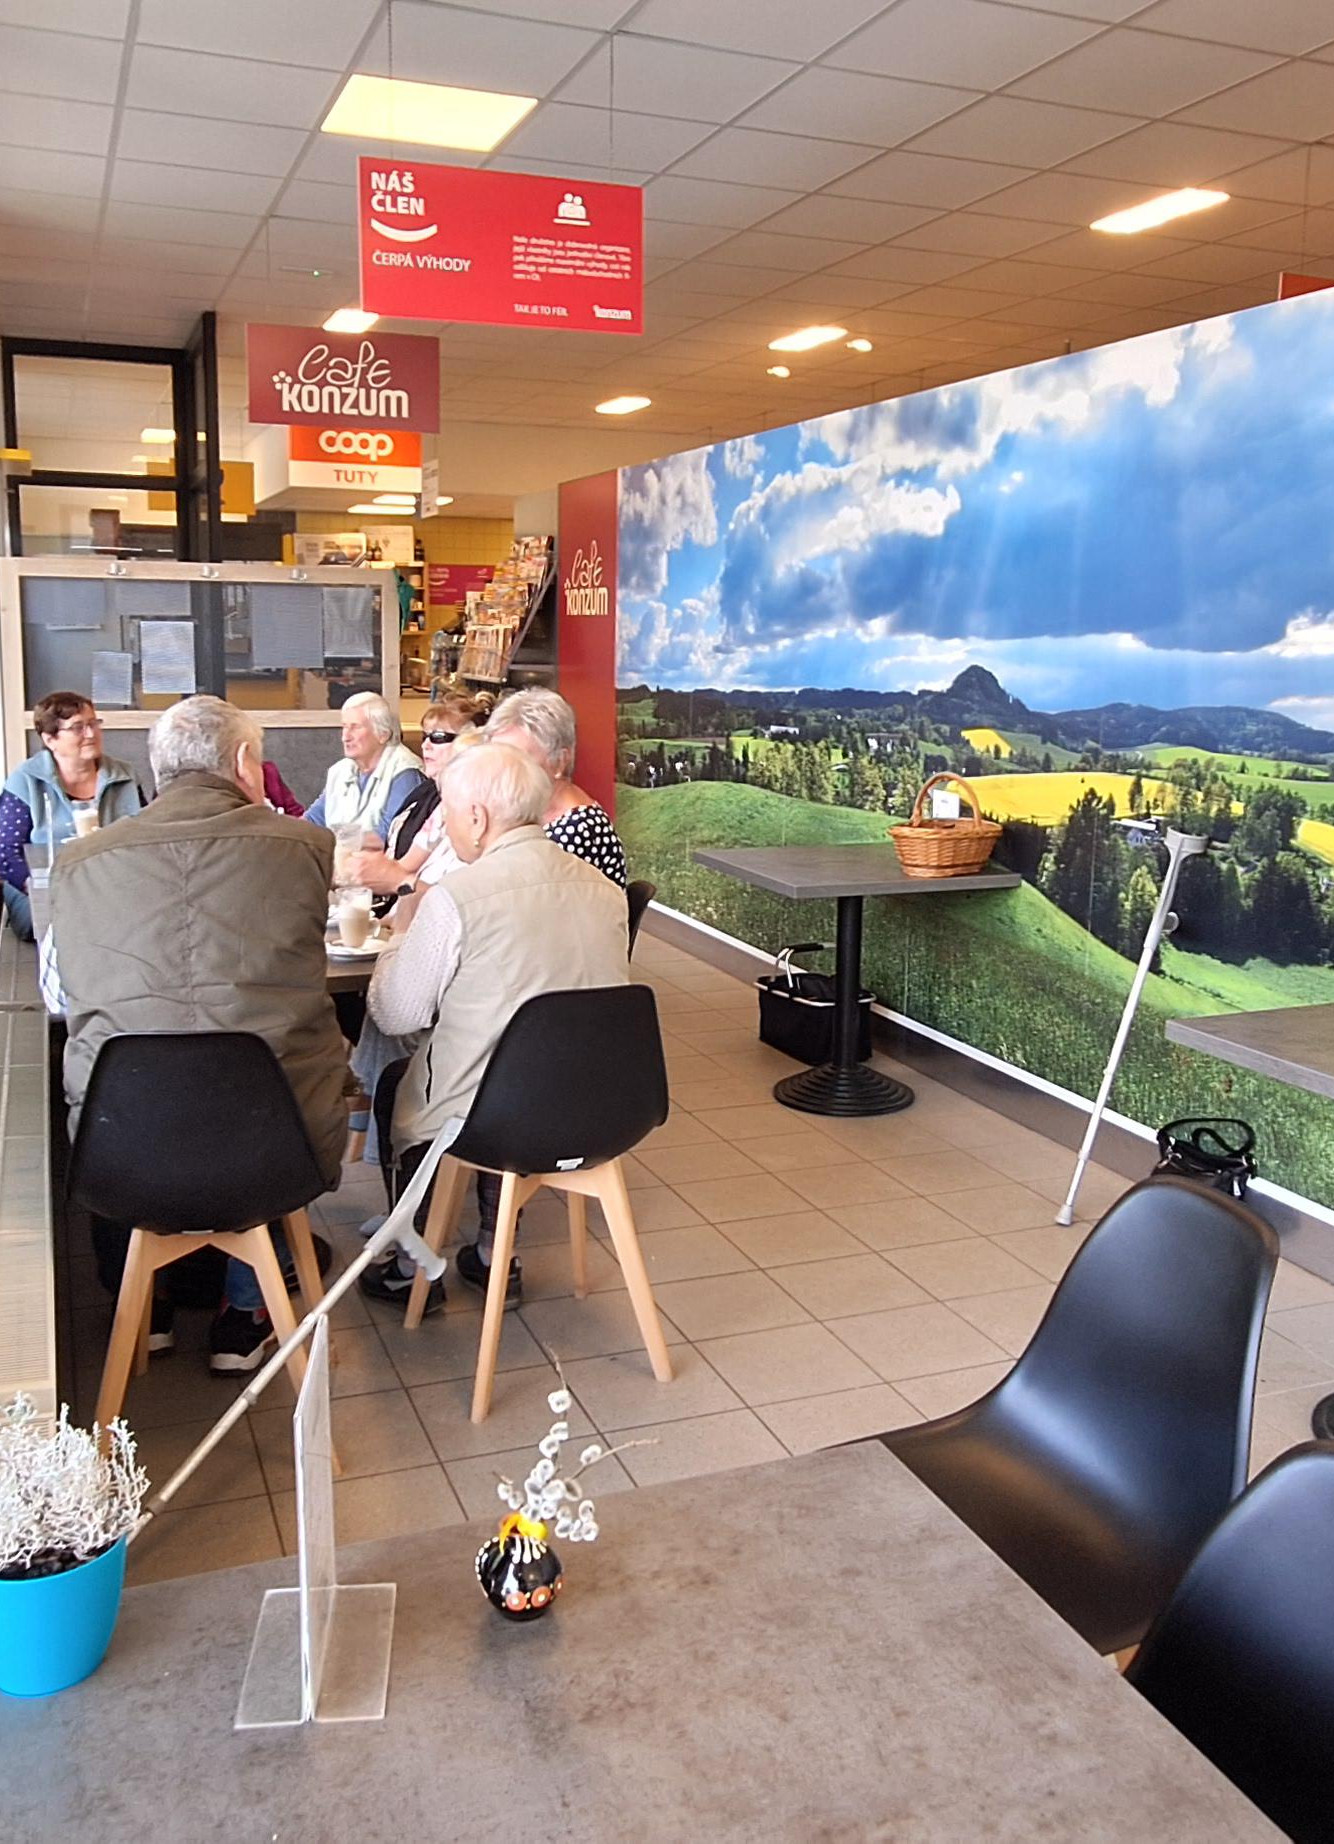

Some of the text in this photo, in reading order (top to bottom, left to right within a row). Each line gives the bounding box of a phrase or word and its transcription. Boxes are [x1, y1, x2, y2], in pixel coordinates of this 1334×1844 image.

[370, 169, 415, 193] NÁŠ
[370, 190, 425, 216] ČLEN
[372, 250, 472, 272] ČERPÁ VÝHODY
[333, 468, 379, 484] TUTY
